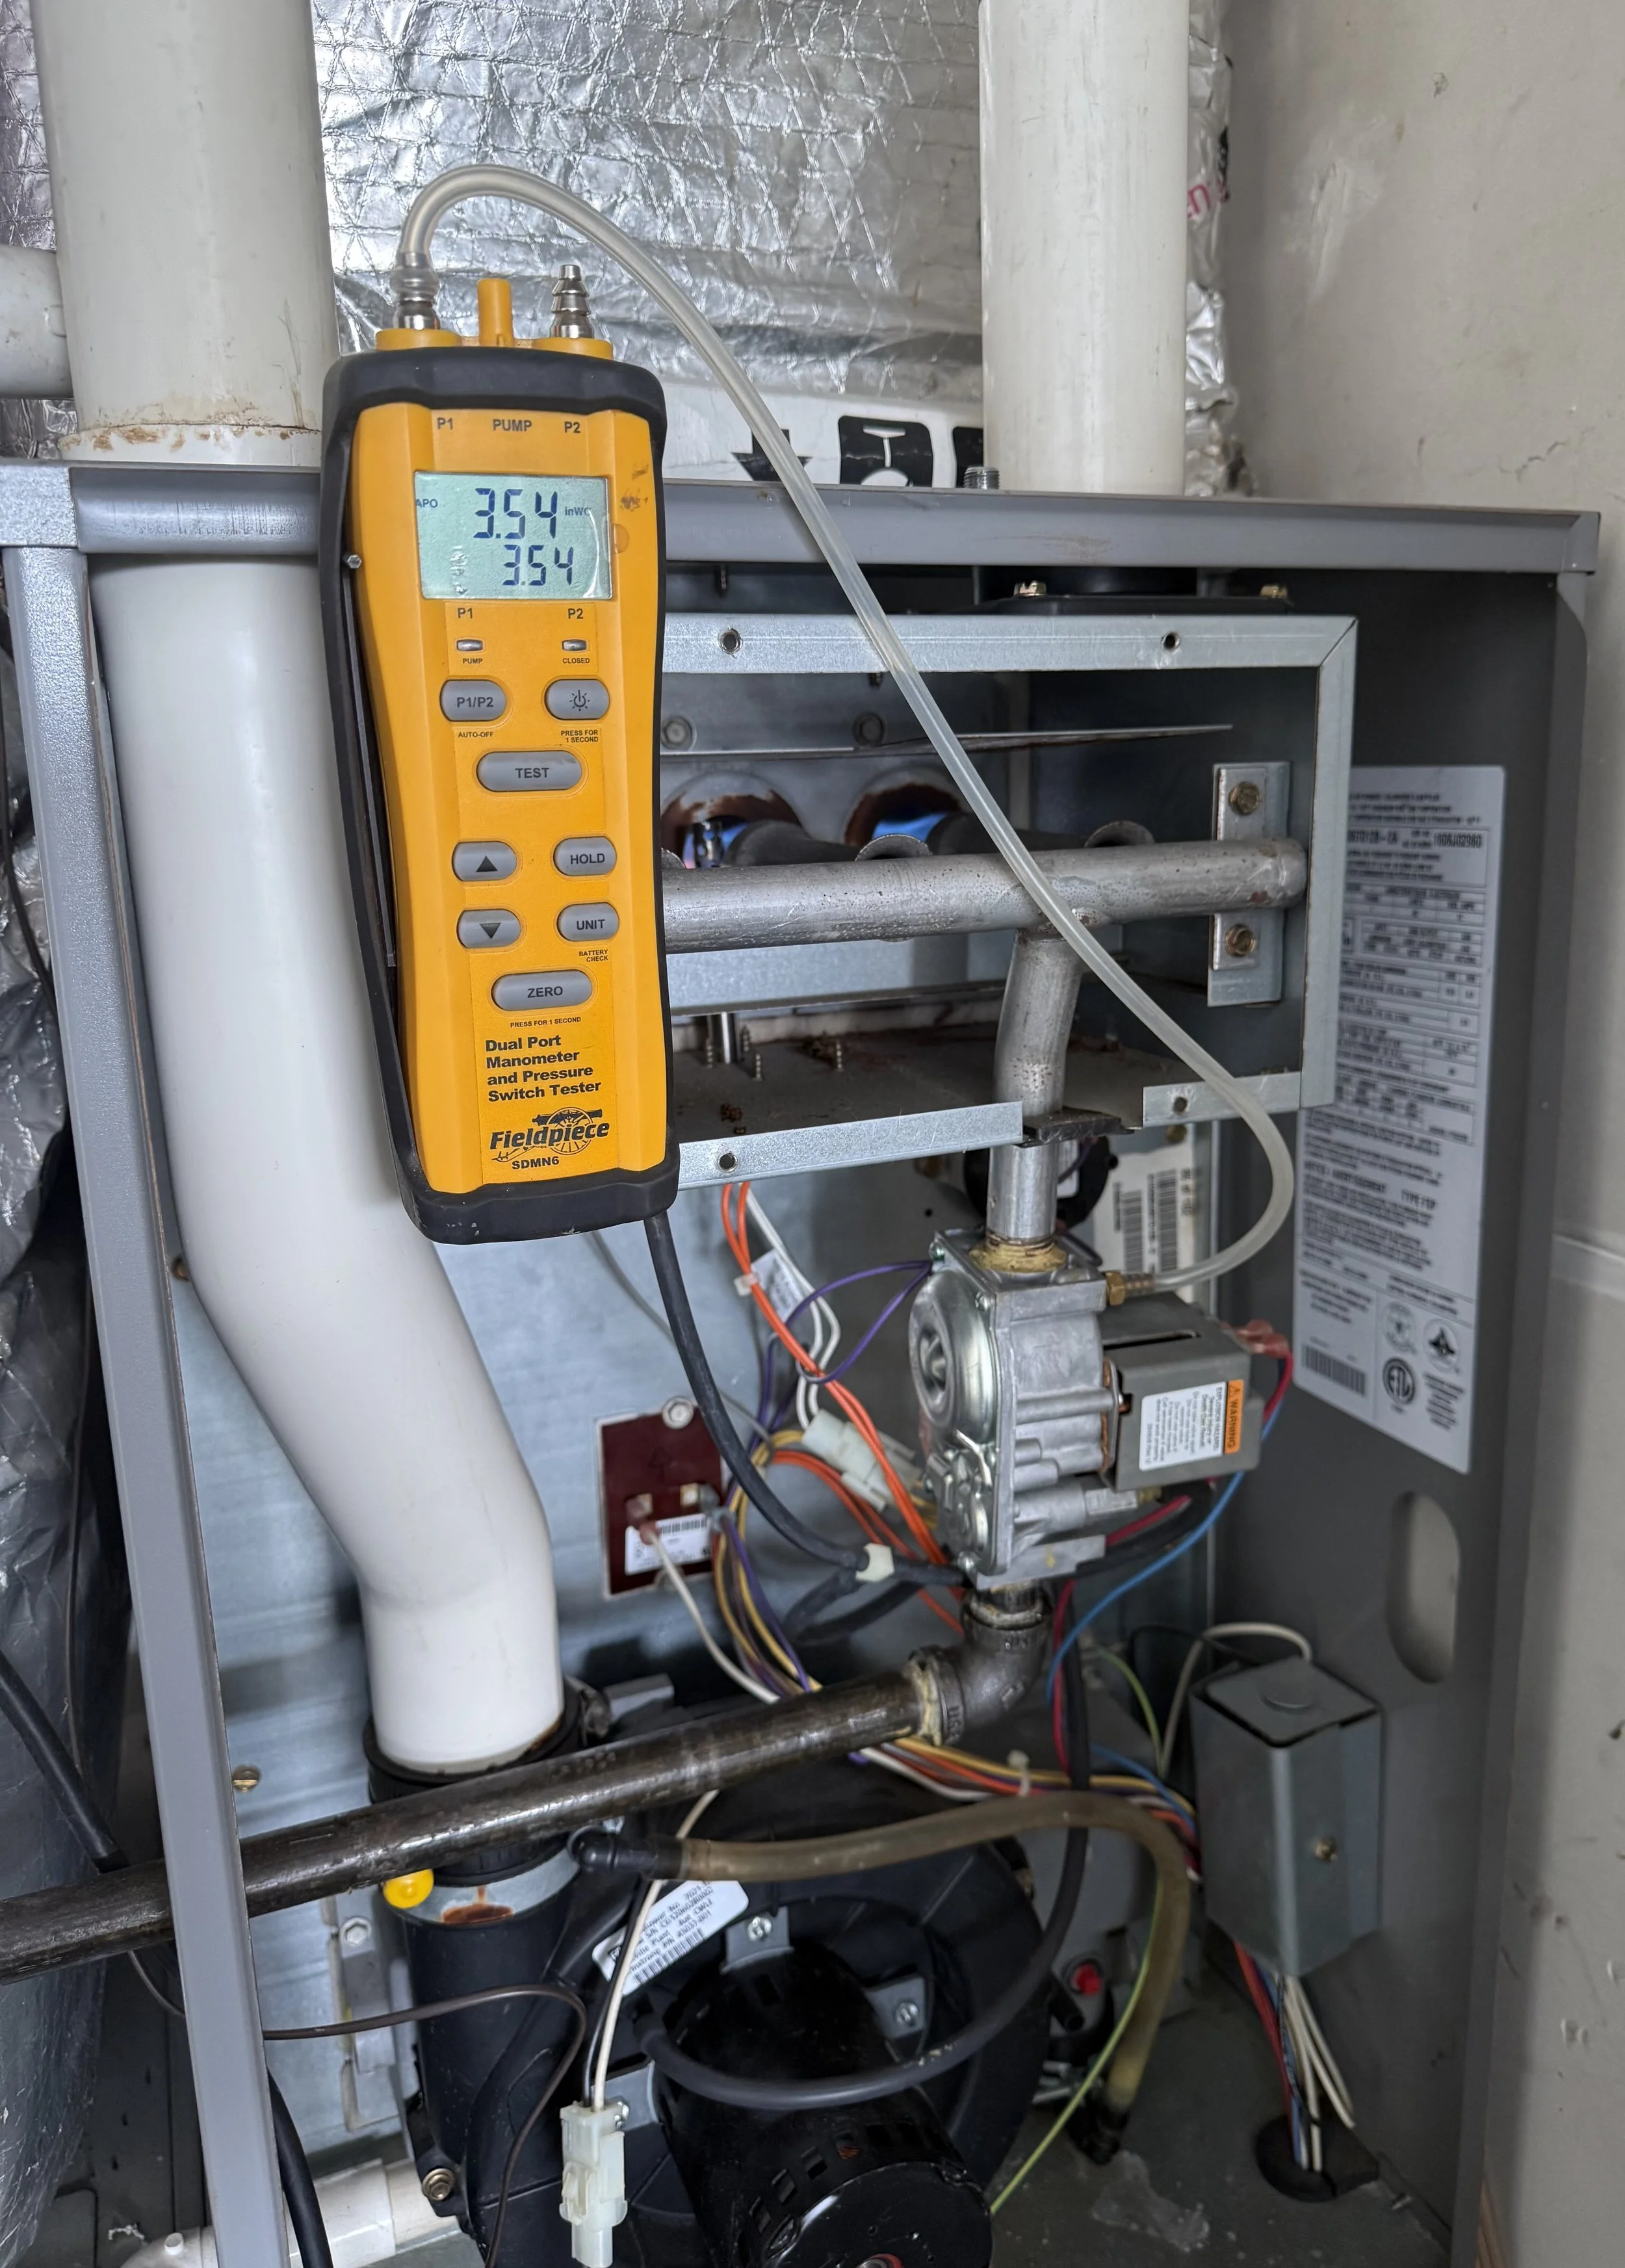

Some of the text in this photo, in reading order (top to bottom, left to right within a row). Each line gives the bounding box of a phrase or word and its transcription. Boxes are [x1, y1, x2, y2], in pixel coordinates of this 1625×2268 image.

[437, 417, 581, 434] P1 PUMP P2
[473, 488, 558, 539] 3.54
[502, 544, 573, 585] 3.54
[457, 607, 584, 619] P1 P2
[456, 696, 494, 709] P1/P2
[515, 767, 550, 779] TEST
[569, 853, 606, 865] HOLD
[576, 919, 606, 931] UNIT
[578, 948, 608, 958] BATTERY
[527, 986, 564, 998] ZERO
[554, 1016, 581, 1024] SECOND
[485, 1034, 562, 1052] Dual Port
[486, 1050, 580, 1069] Manometer
[487, 1066, 593, 1086] and Pressure
[488, 1080, 601, 1102] Switch Tester
[489, 1121, 610, 1150] Fieldpiece
[512, 1156, 560, 1169] SDMN6
[1227, 1399, 1238, 1448] WARNING
